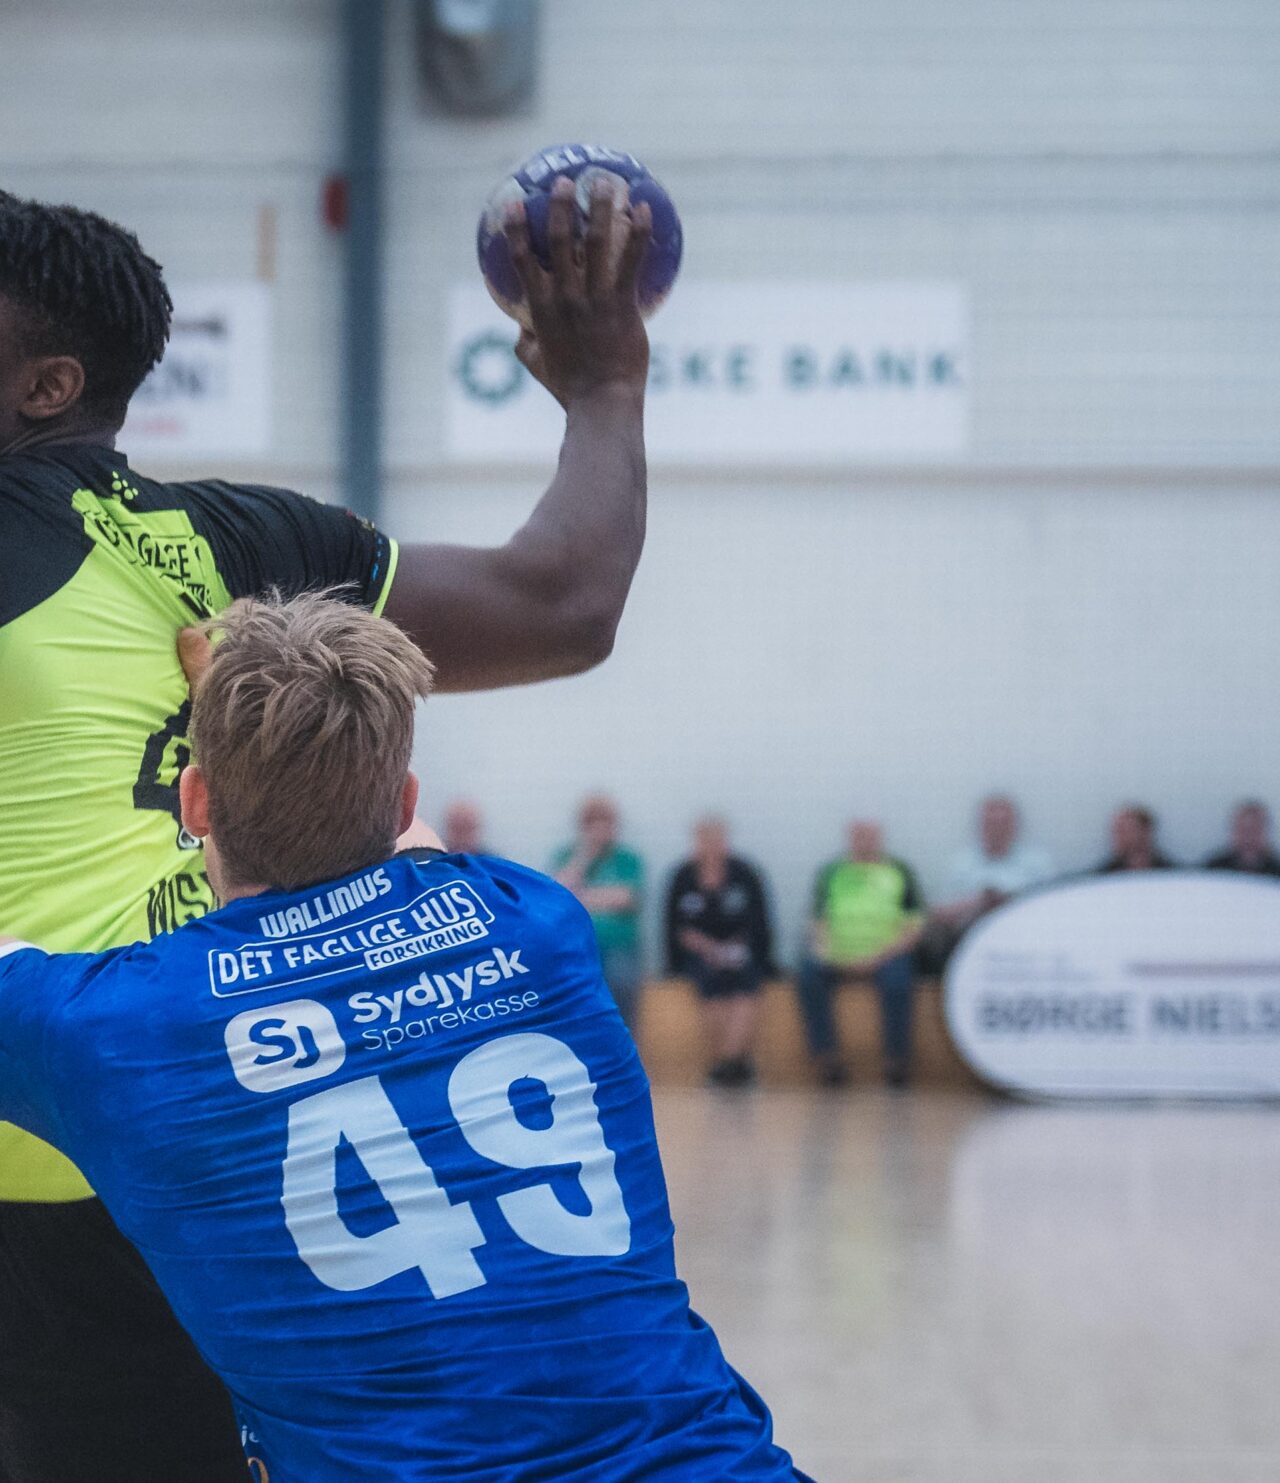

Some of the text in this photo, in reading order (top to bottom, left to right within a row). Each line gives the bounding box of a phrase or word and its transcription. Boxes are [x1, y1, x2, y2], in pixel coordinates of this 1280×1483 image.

[649, 344, 960, 392] SKE BANK
[219, 887, 476, 984] DET FAGLIGE HUS
[259, 868, 393, 938] WALLINIUS
[370, 920, 484, 967] FORSIKRING
[348, 948, 530, 1024] Sydjysk
[362, 991, 540, 1051] Sparekasse
[281, 1033, 631, 1299] 49
